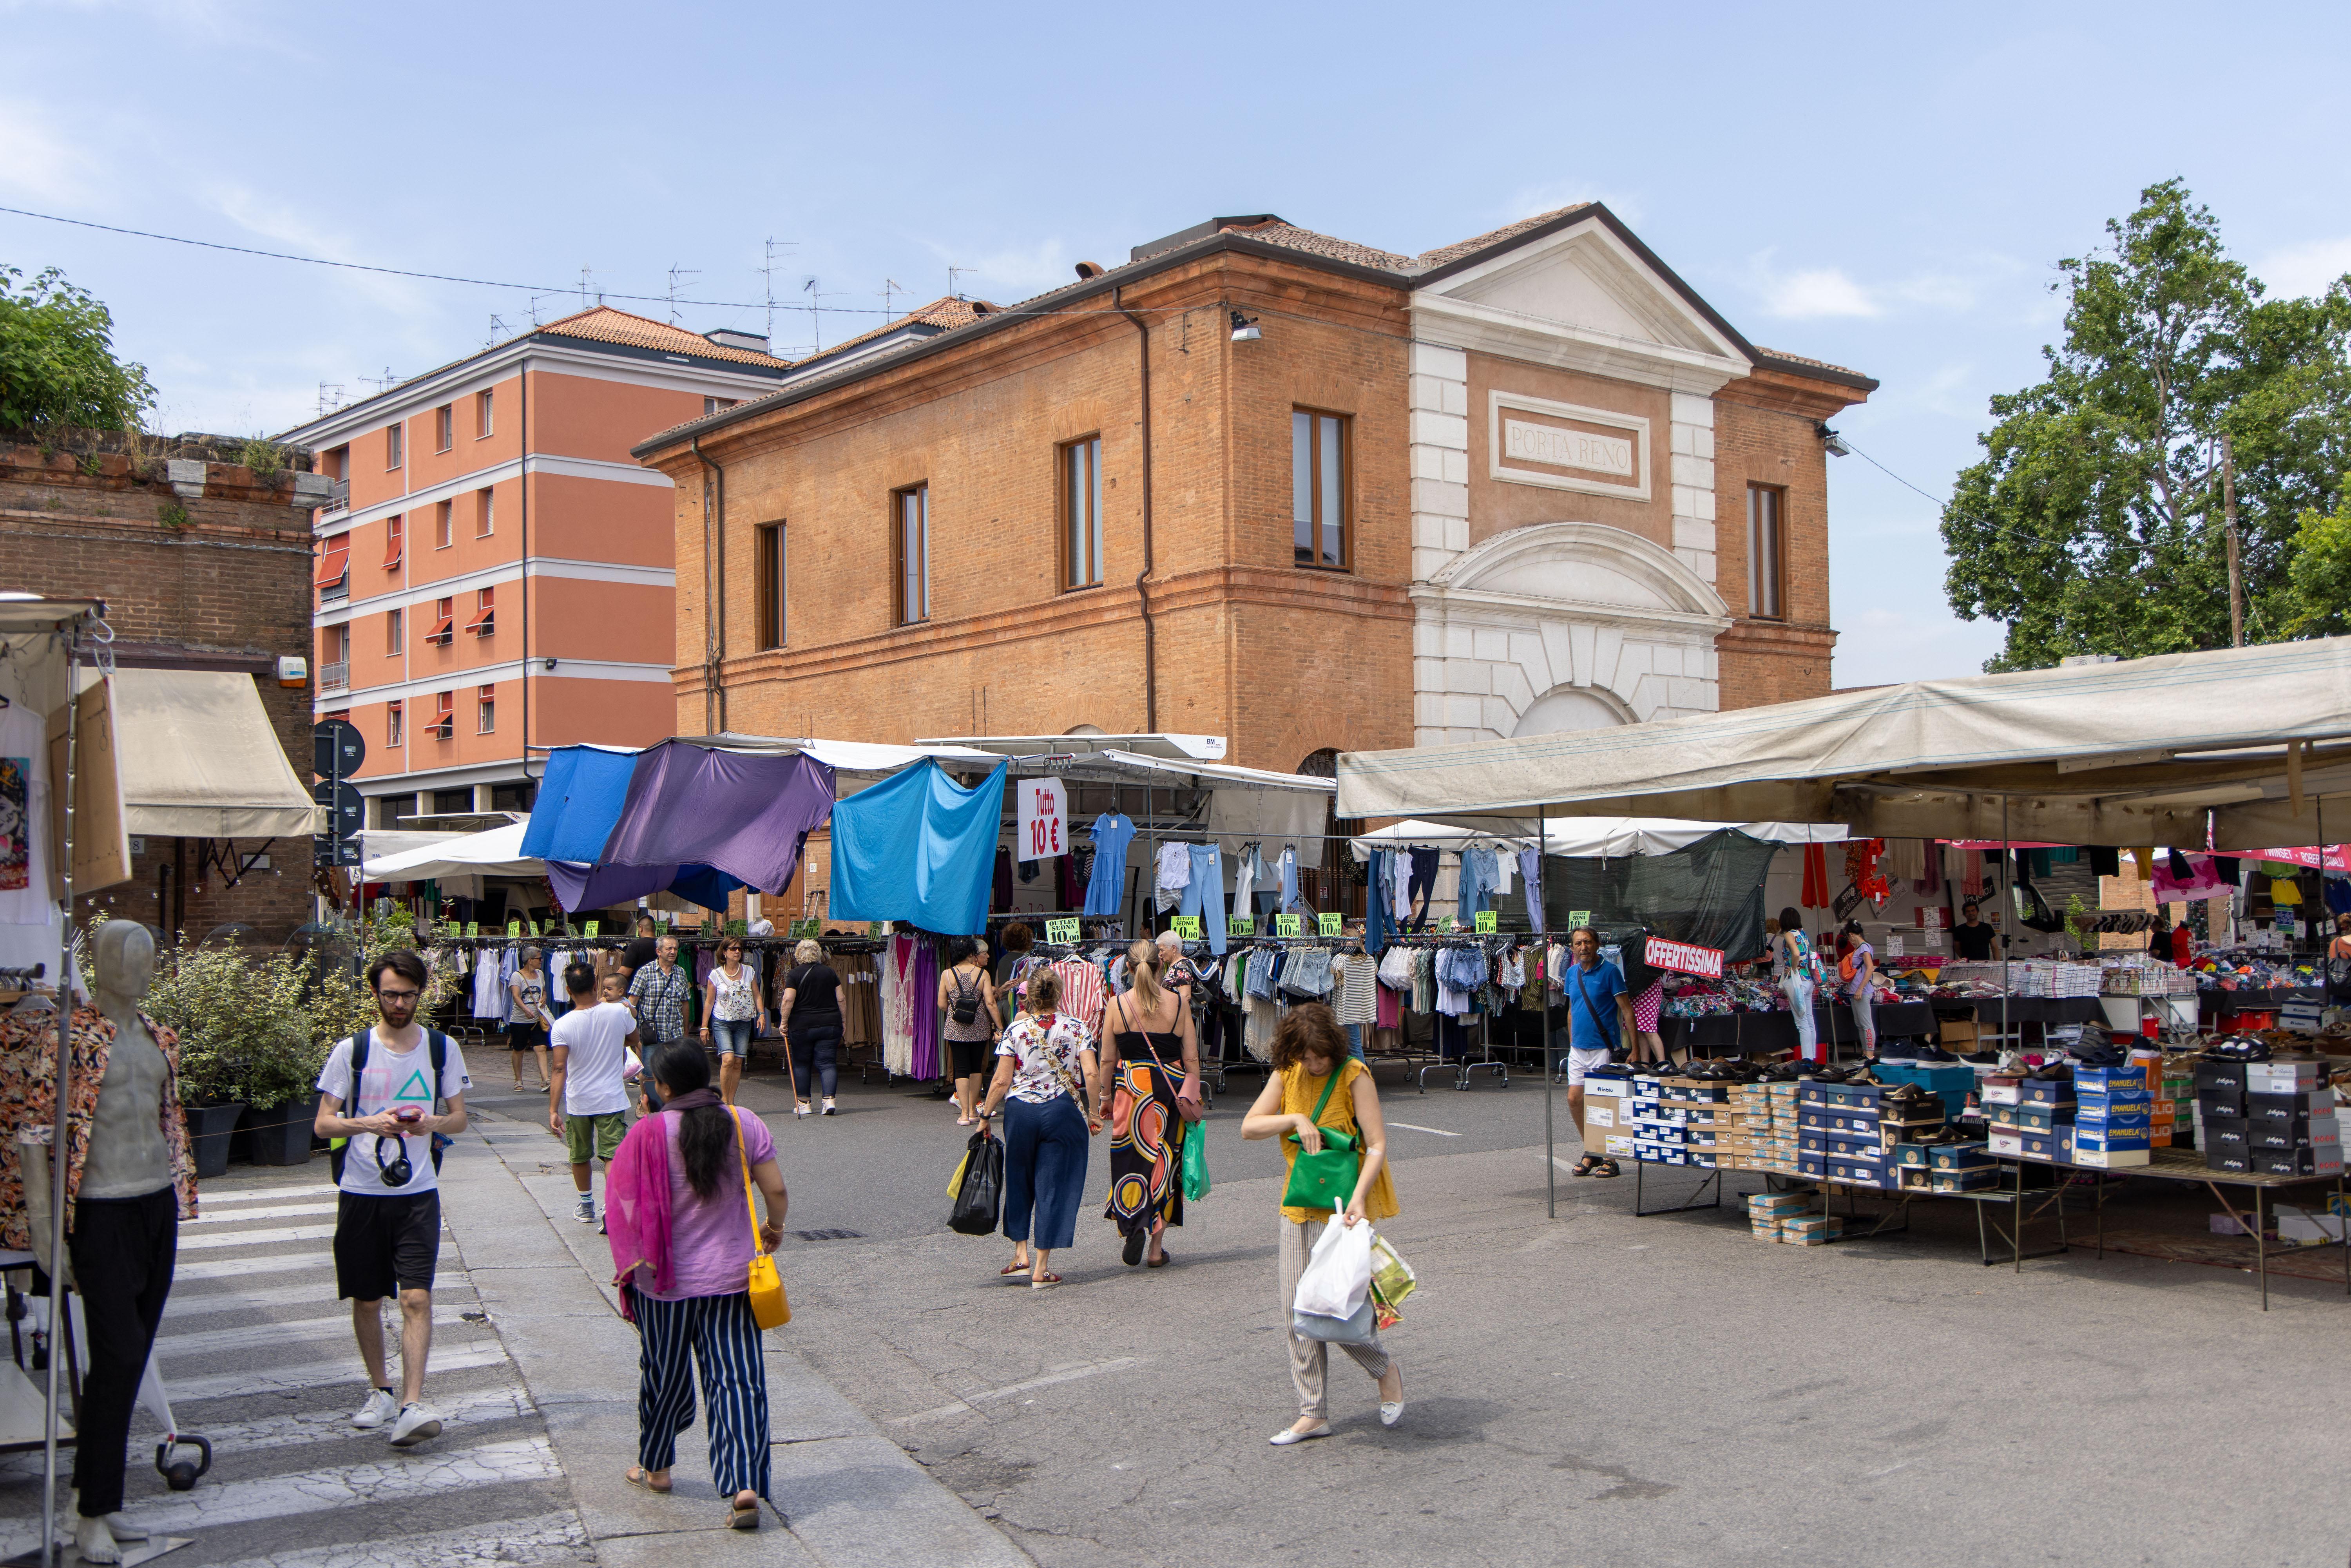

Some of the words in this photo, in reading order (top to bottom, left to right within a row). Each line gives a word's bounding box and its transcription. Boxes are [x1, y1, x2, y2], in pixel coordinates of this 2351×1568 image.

[1512, 427, 1572, 460] PORTA
[1579, 438, 1627, 468] RENO
[1036, 788, 1054, 816] Tutto
[1031, 818, 1046, 855] 10
[1051, 817, 1059, 853] €
[2264, 848, 2292, 860] TWINSET
[2301, 852, 2325, 865] ROBERO
[2326, 856, 2345, 867] CAVALLI
[1232, 923, 1253, 934] 10,00
[1320, 923, 1340, 934] 1000
[1436, 924, 1449, 934] 1000
[1477, 922, 1495, 932] 1000
[1050, 931, 1079, 943] 1000
[1646, 939, 1721, 976] OFFERTISSIMA
[2112, 1104, 2141, 1112] EMANUELA
[2109, 1128, 2139, 1136] EMANUELA
